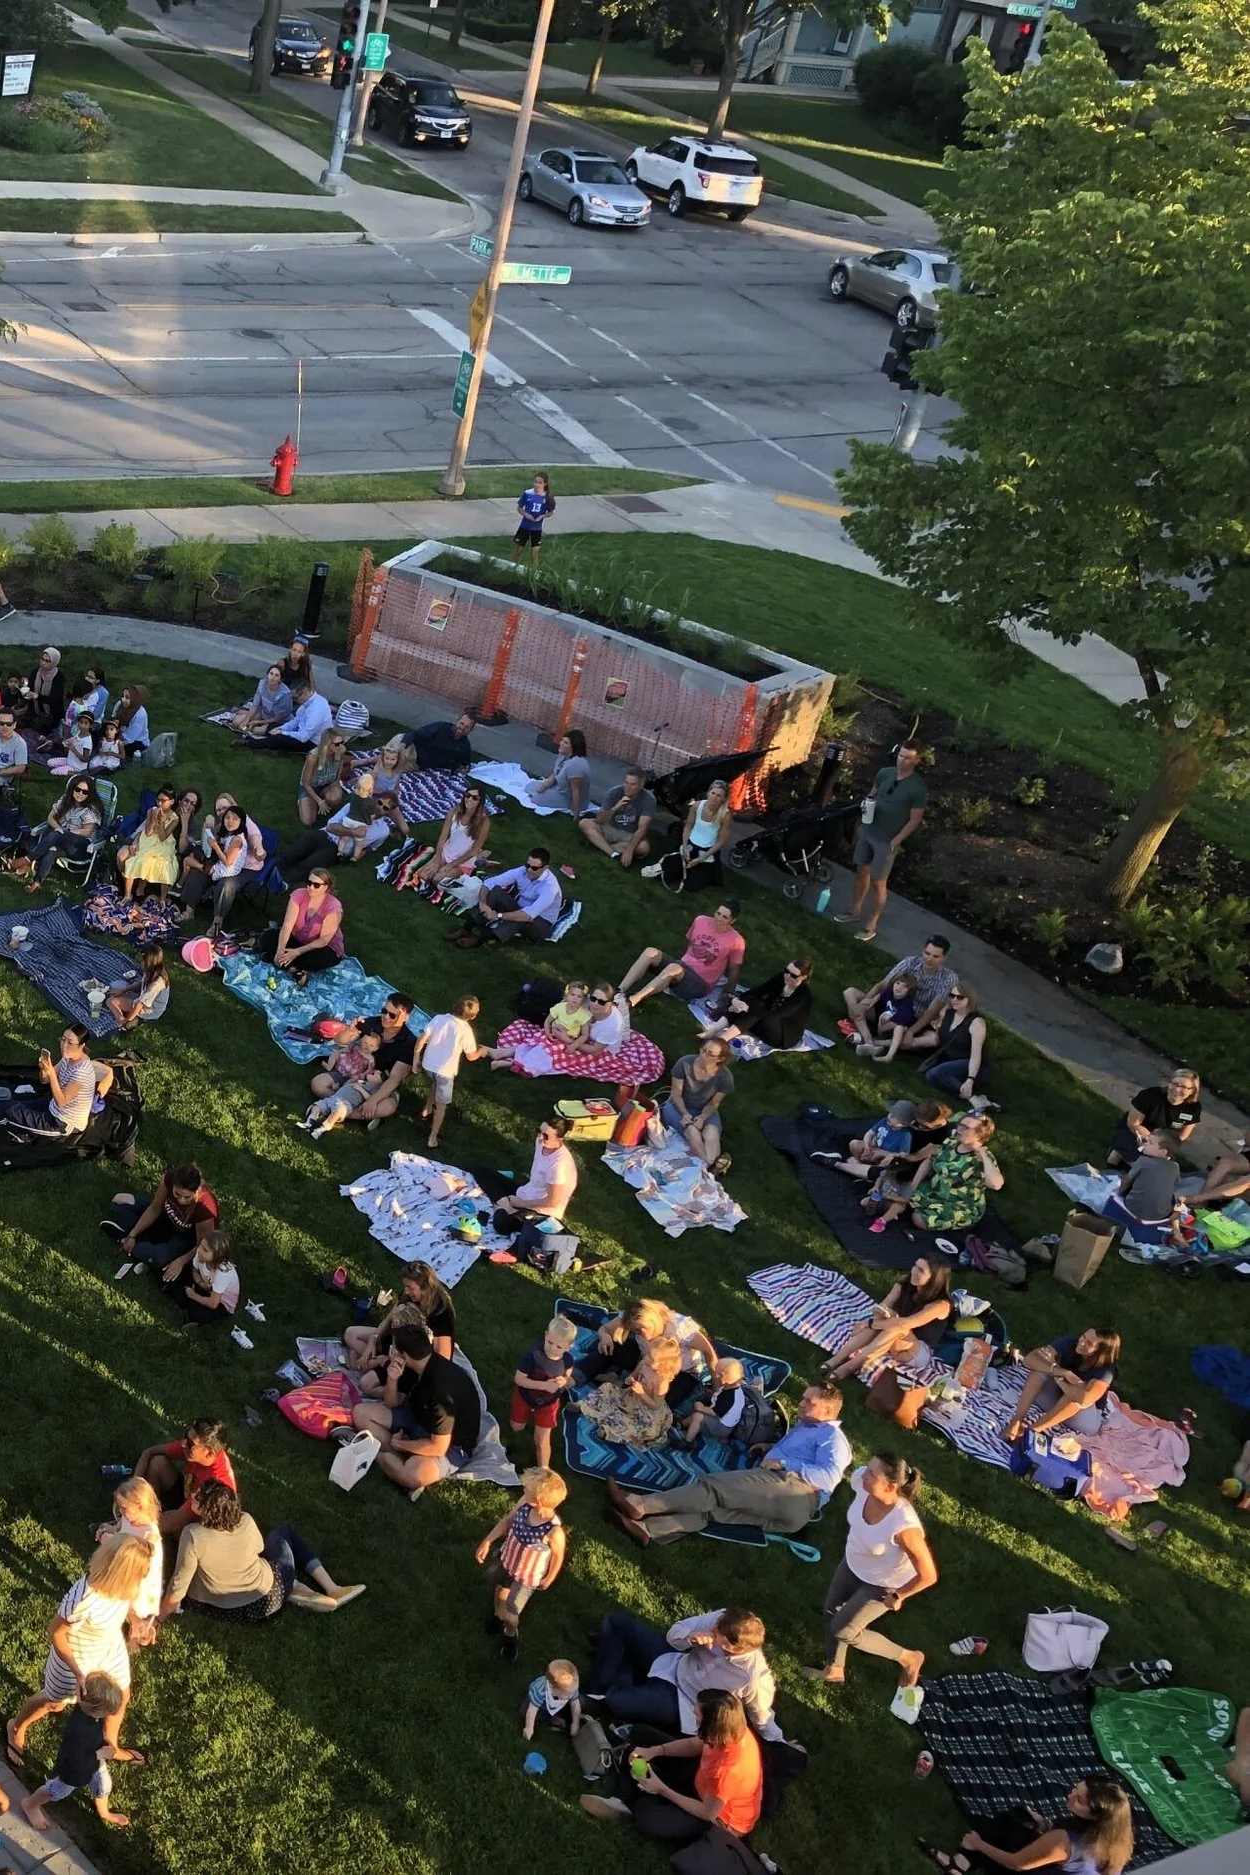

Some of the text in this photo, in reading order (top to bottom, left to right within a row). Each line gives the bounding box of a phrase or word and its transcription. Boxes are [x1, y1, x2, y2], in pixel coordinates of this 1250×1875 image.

[471, 238, 488, 255] PARK
[502, 265, 558, 281] WILMETTE
[531, 502, 542, 513] 13
